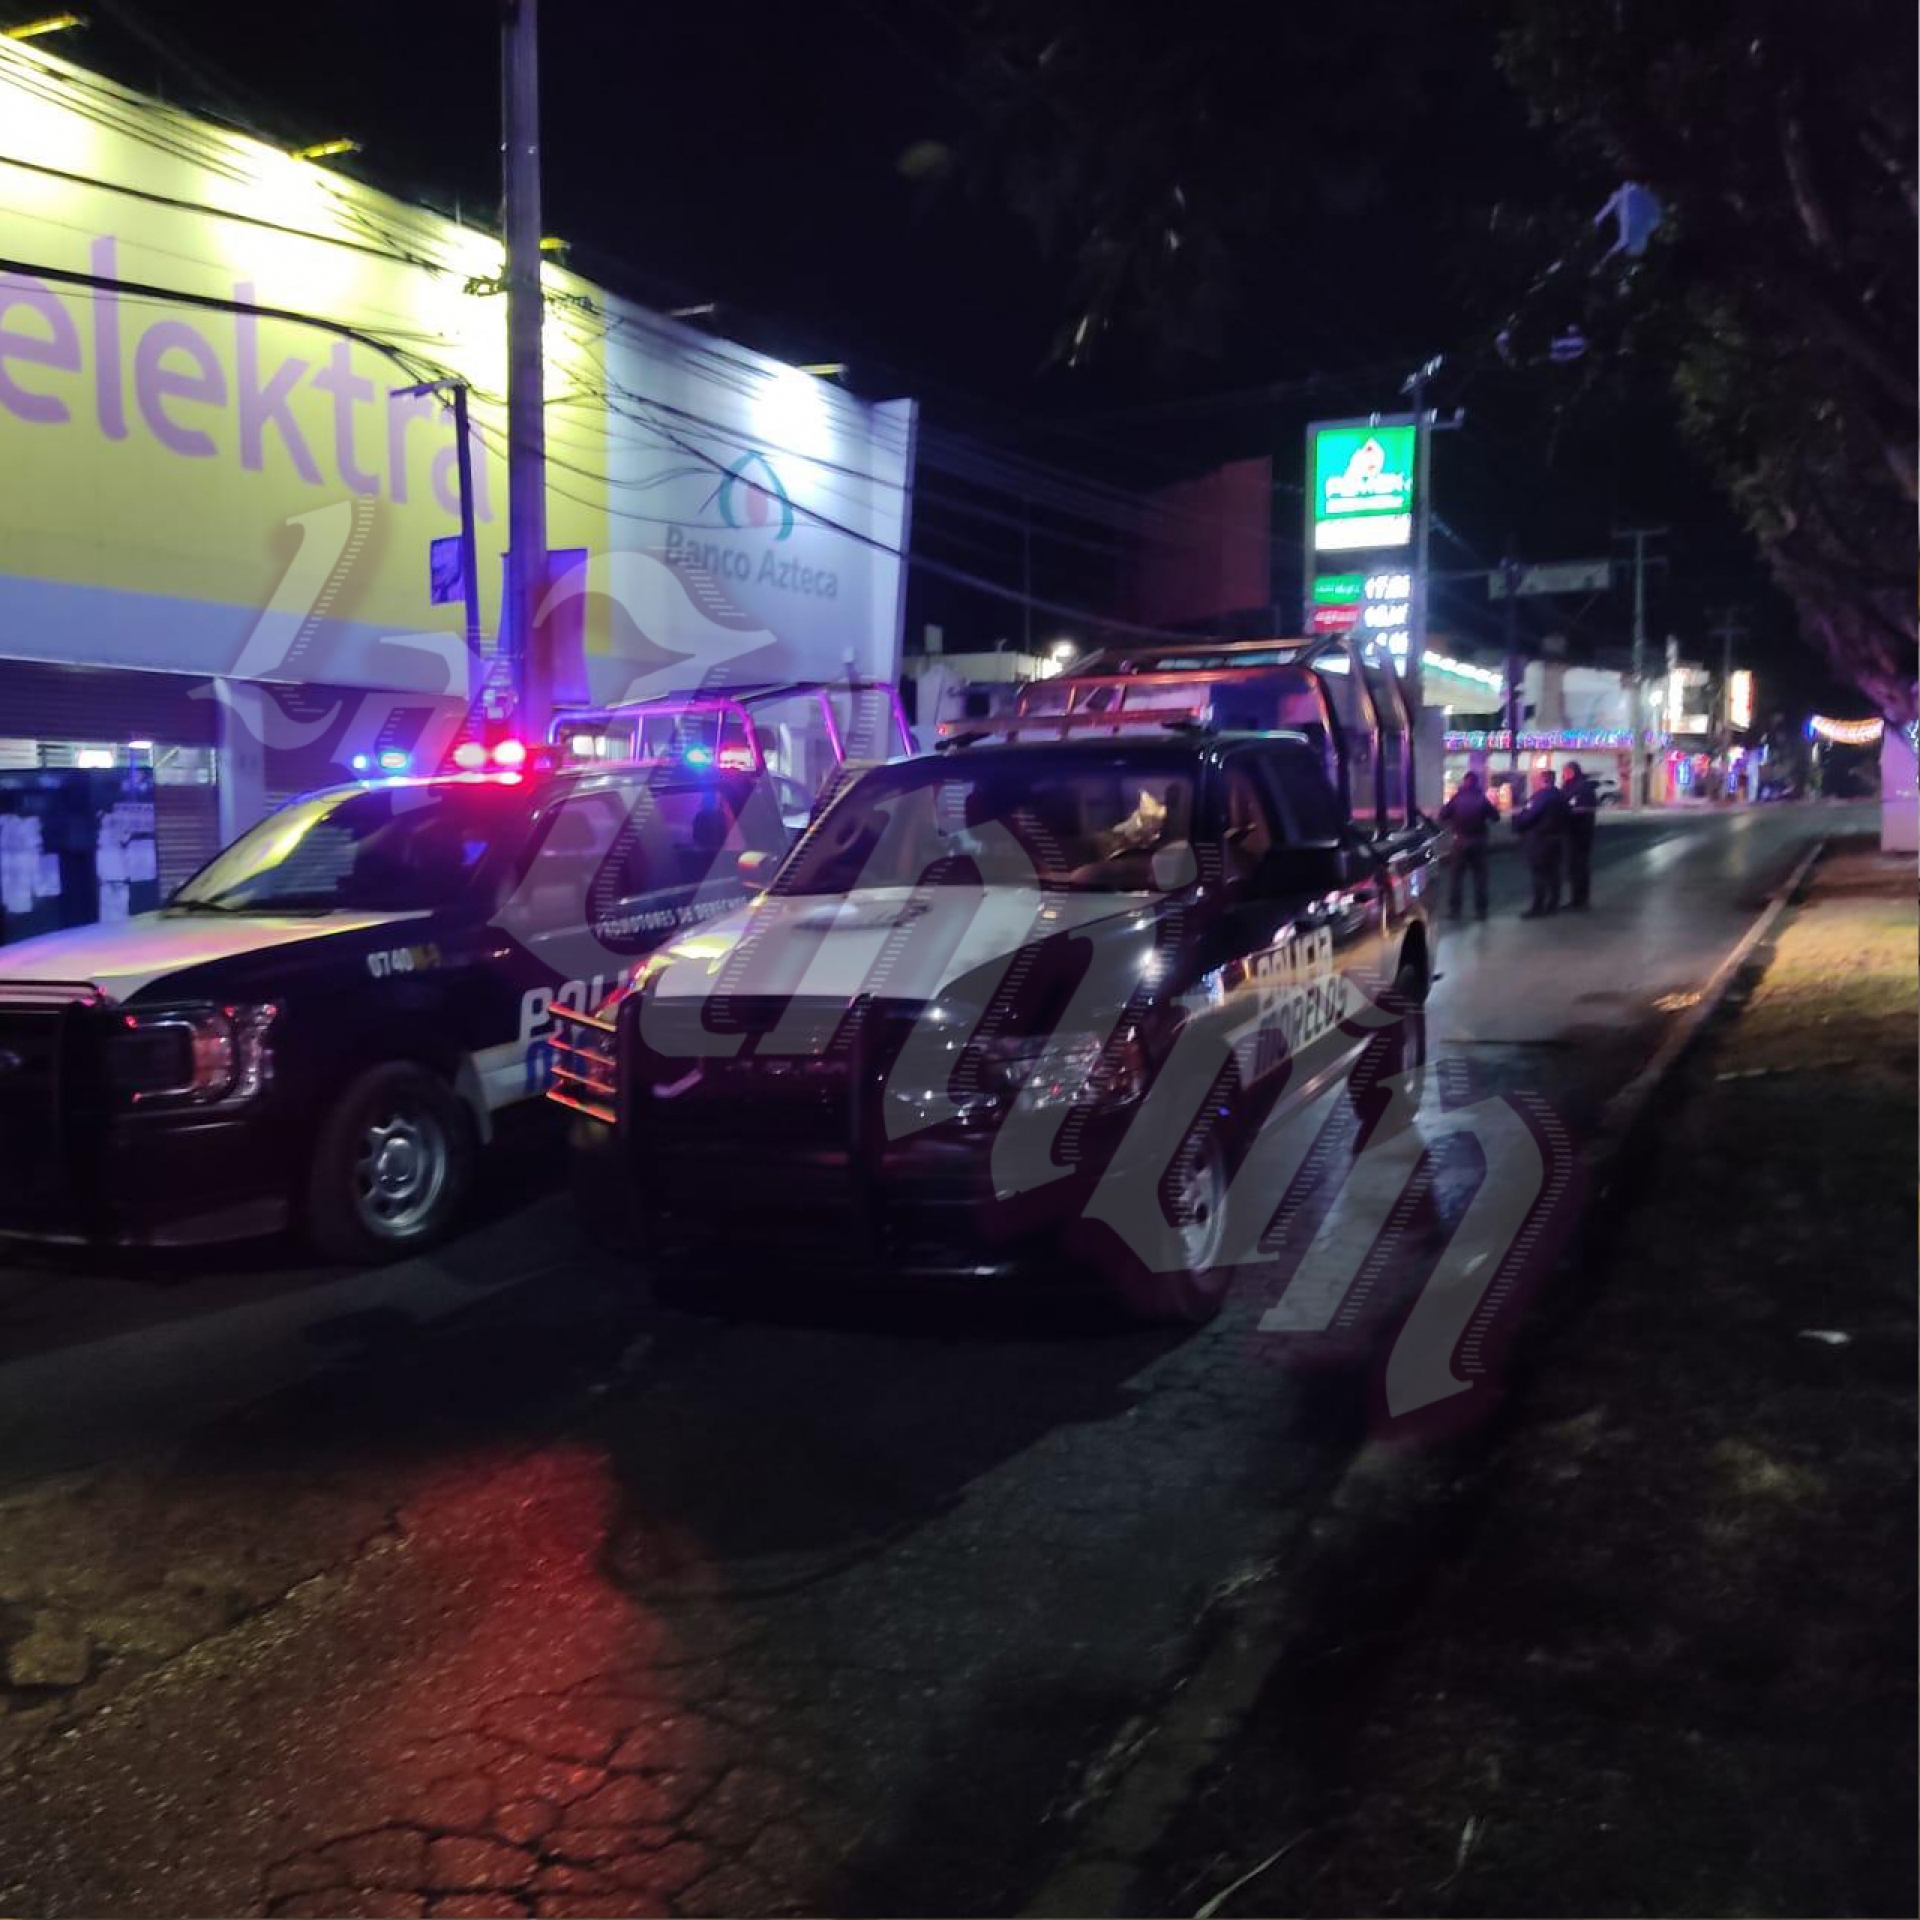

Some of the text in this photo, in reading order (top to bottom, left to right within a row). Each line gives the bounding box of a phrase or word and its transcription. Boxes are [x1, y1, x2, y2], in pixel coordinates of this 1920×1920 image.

[0, 235, 494, 523] elektra
[665, 525, 839, 600] Banco Azteca
